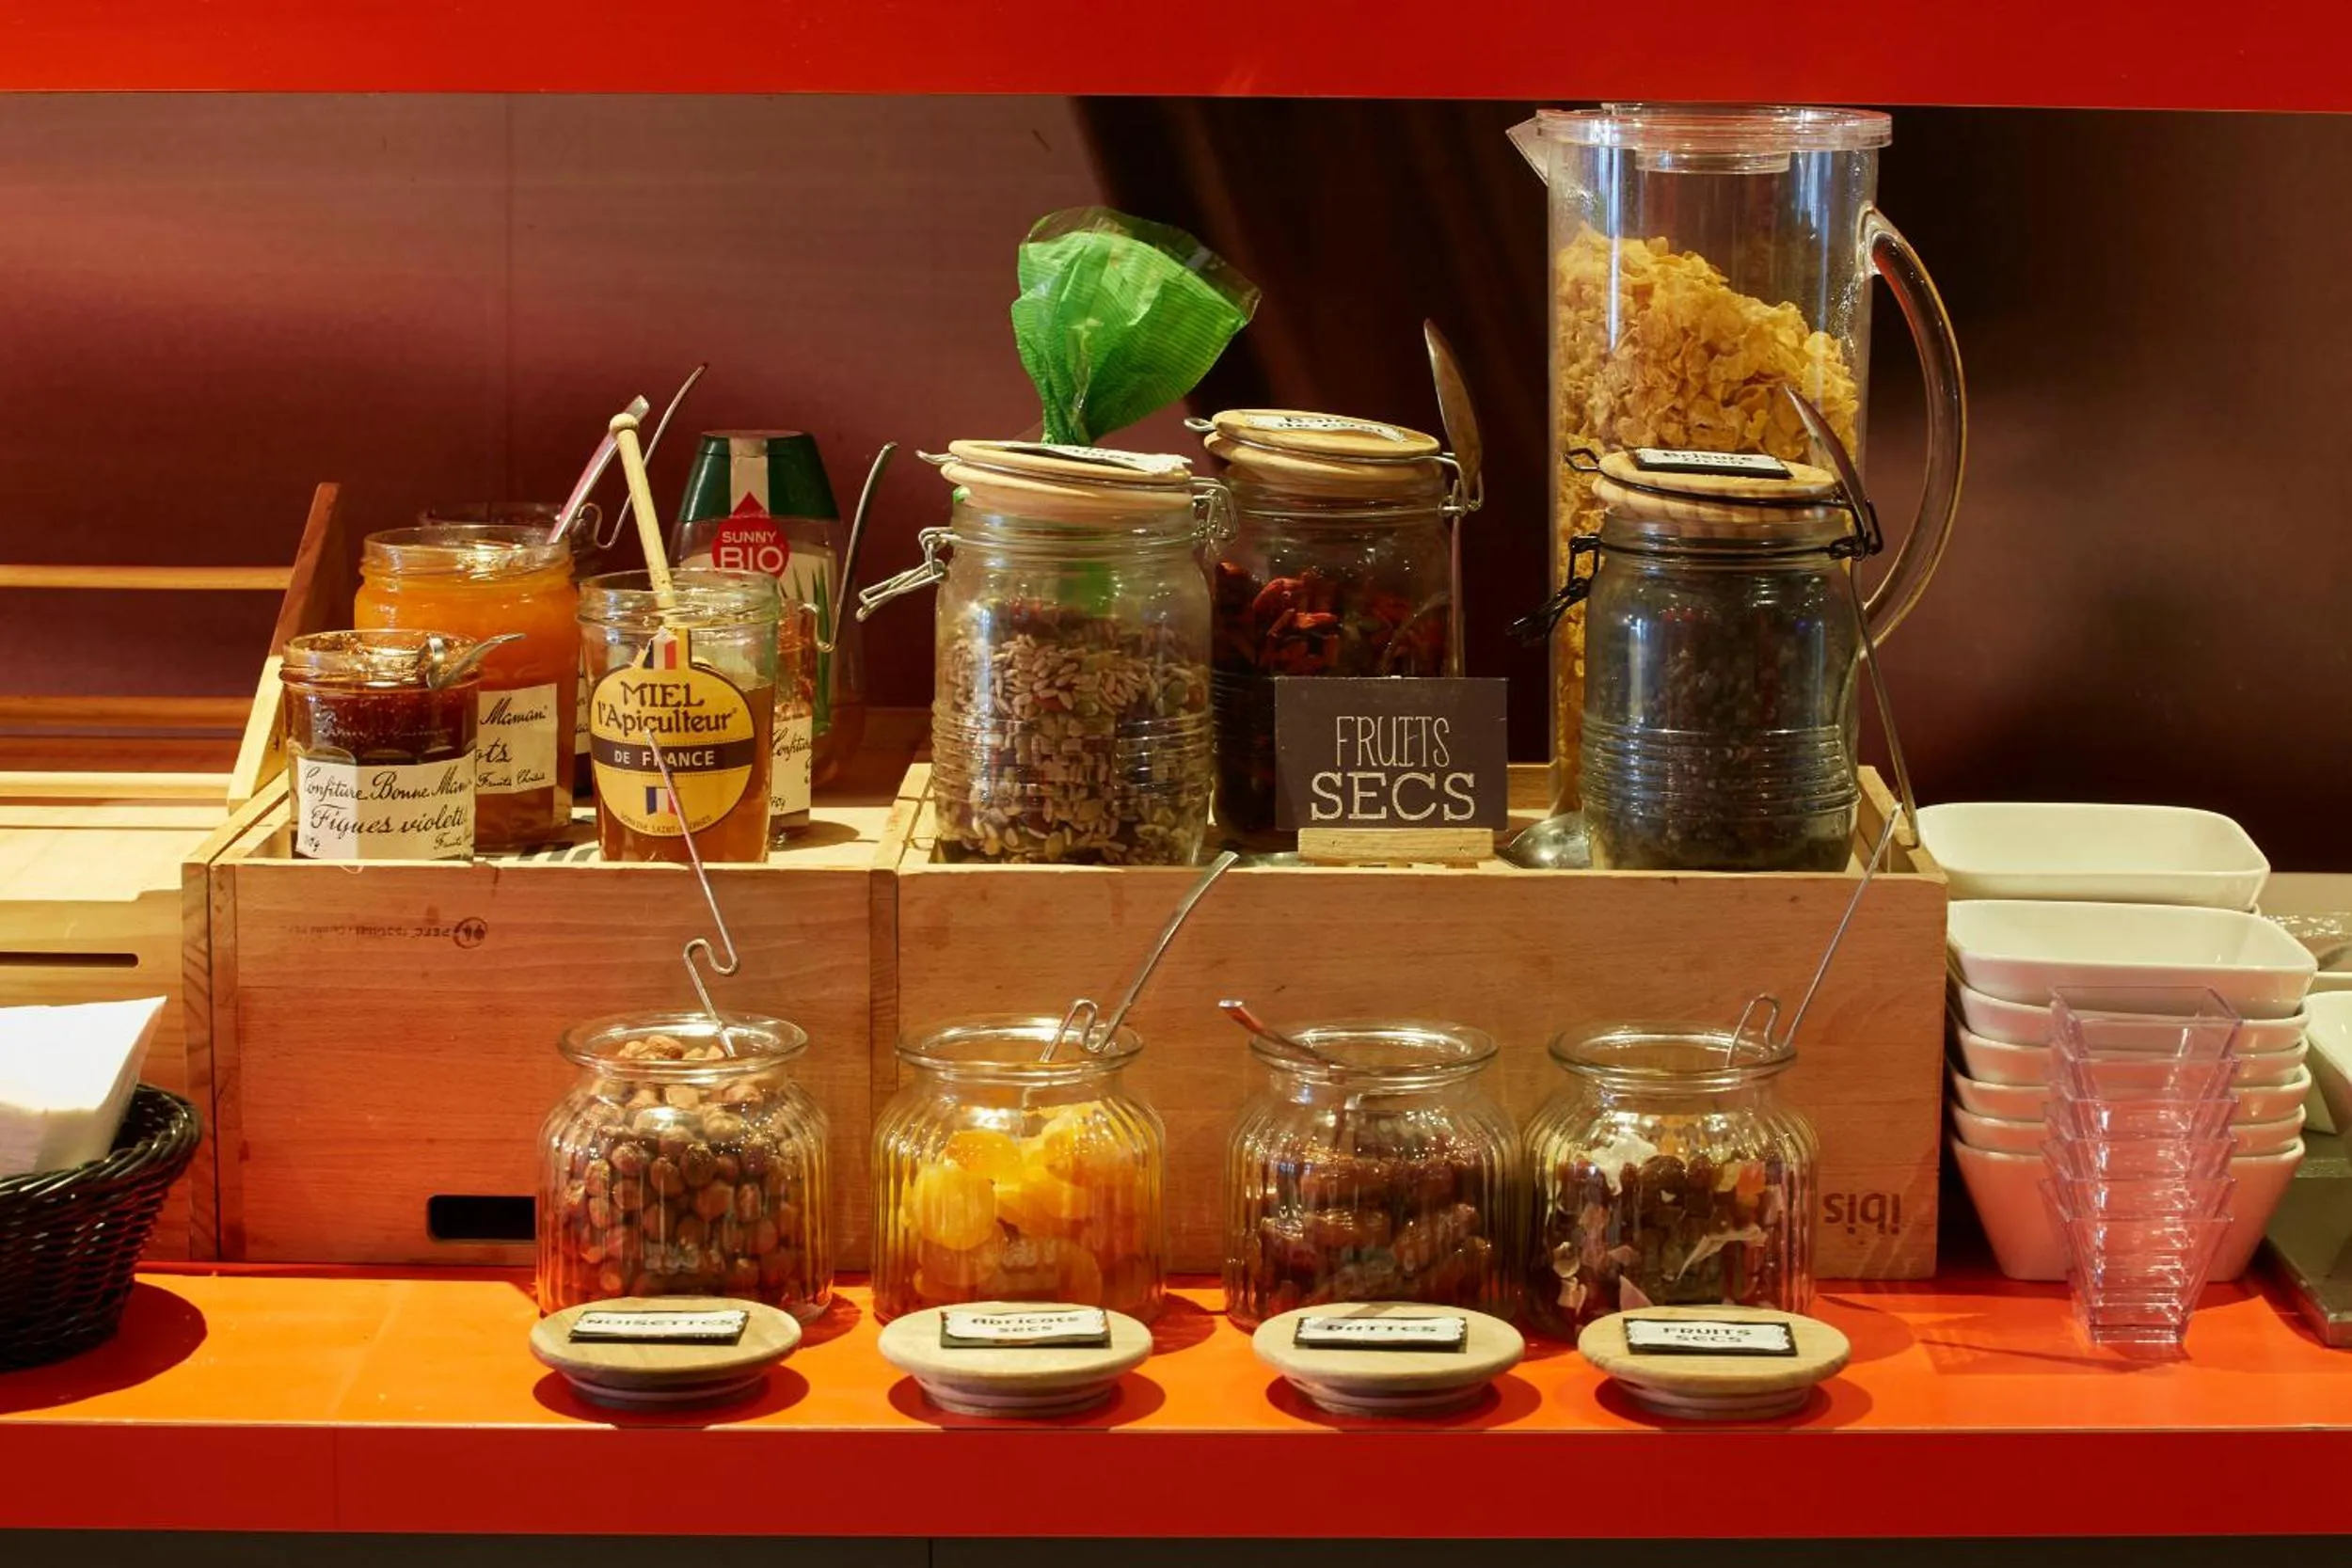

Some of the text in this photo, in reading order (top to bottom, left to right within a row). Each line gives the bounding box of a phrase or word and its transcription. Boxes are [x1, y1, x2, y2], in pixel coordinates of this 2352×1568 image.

[722, 531, 777, 544] SUNNY
[720, 546, 784, 573] BIO
[620, 681, 705, 707] MIEL
[597, 700, 733, 736] l'Apiculteur
[614, 751, 630, 765] DE
[1336, 716, 1450, 768] FRUITS
[304, 767, 369, 800] Confiture
[365, 770, 429, 800] Bonne
[1311, 771, 1475, 821] SECS
[310, 803, 393, 840] Figues
[1823, 1193, 1900, 1236] ibis
[1663, 1327, 1751, 1336] FRUITS
